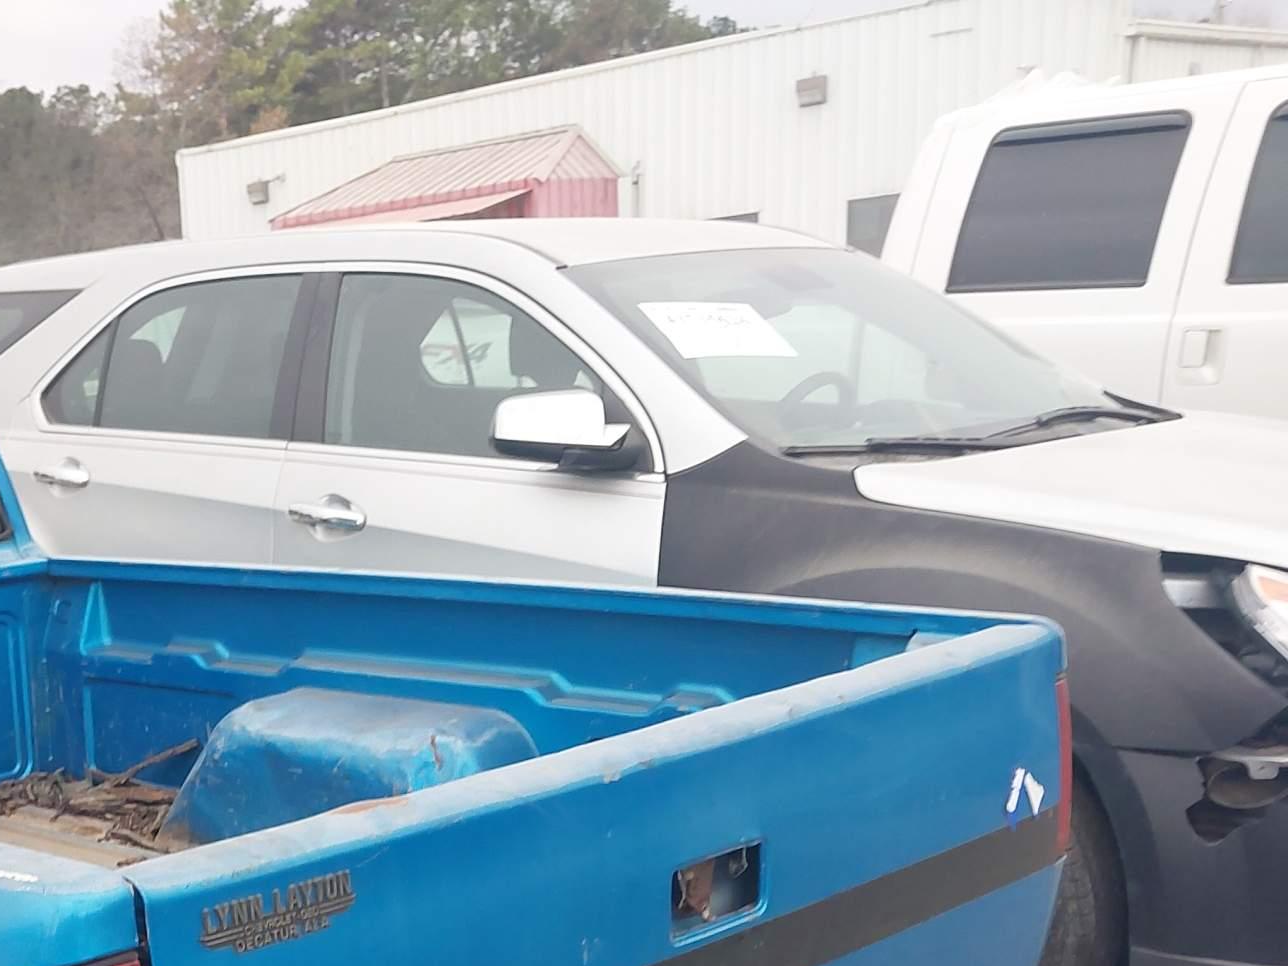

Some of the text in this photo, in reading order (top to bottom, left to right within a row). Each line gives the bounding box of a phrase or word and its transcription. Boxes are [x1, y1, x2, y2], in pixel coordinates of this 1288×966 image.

[202, 869, 351, 935] LYNN LAYTON
[233, 922, 298, 953] DECATUR
